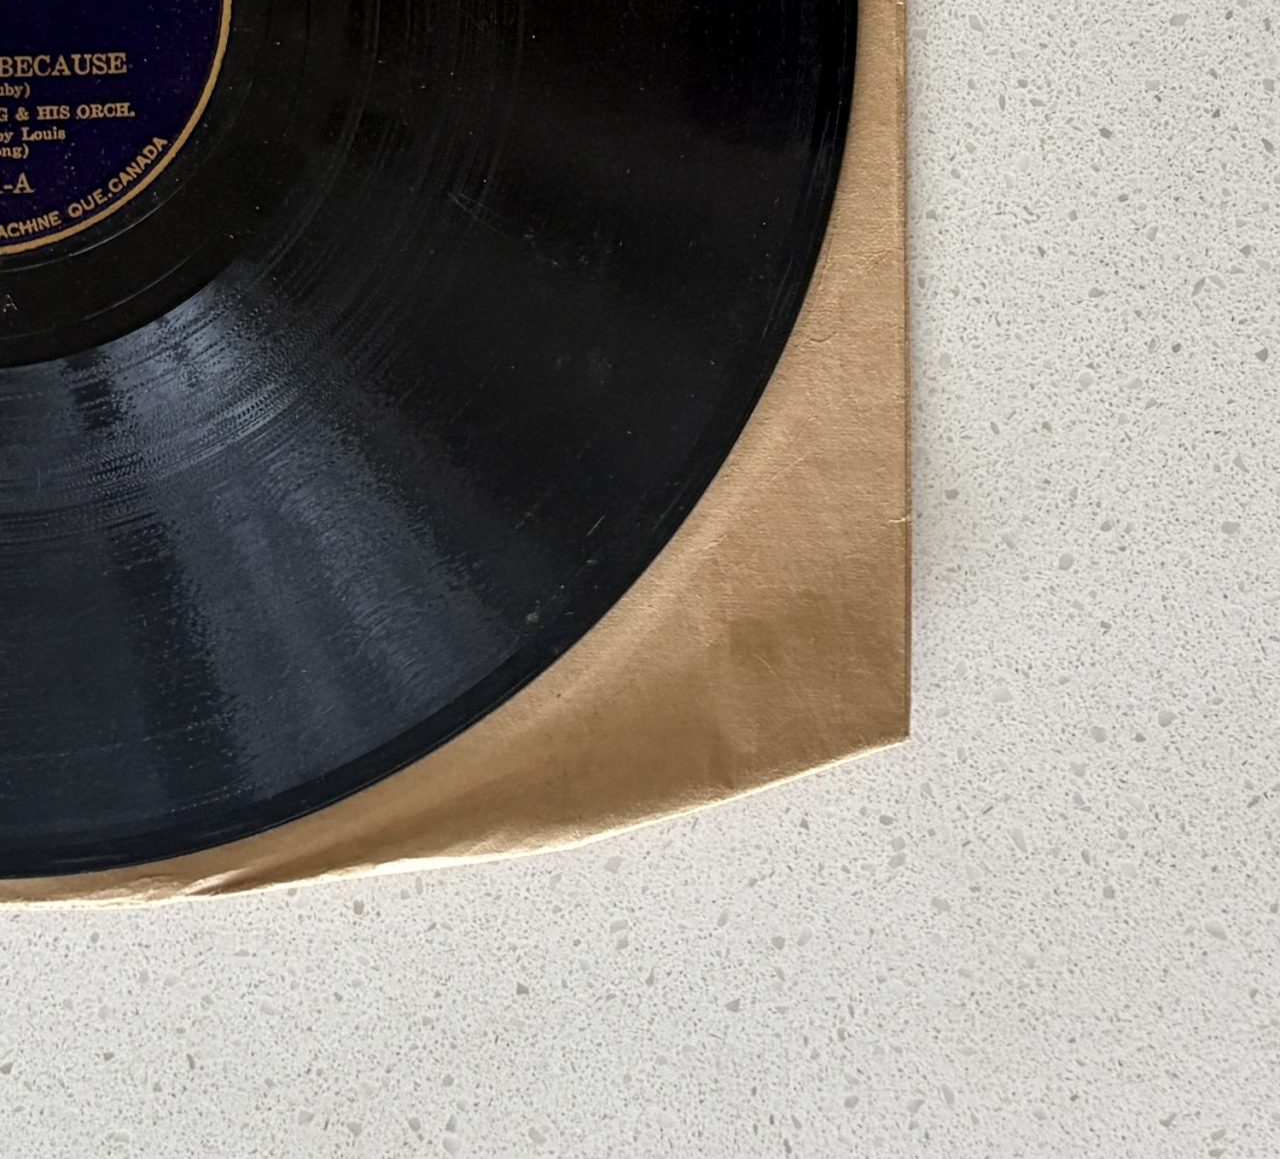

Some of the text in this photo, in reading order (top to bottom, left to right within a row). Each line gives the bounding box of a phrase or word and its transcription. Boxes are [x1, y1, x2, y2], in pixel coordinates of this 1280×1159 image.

[15, 106, 30, 121] &
[37, 105, 71, 120] HIS
[76, 102, 136, 120] ORCH.
[21, 126, 66, 141] Louis
[107, 135, 169, 194] CANADA
